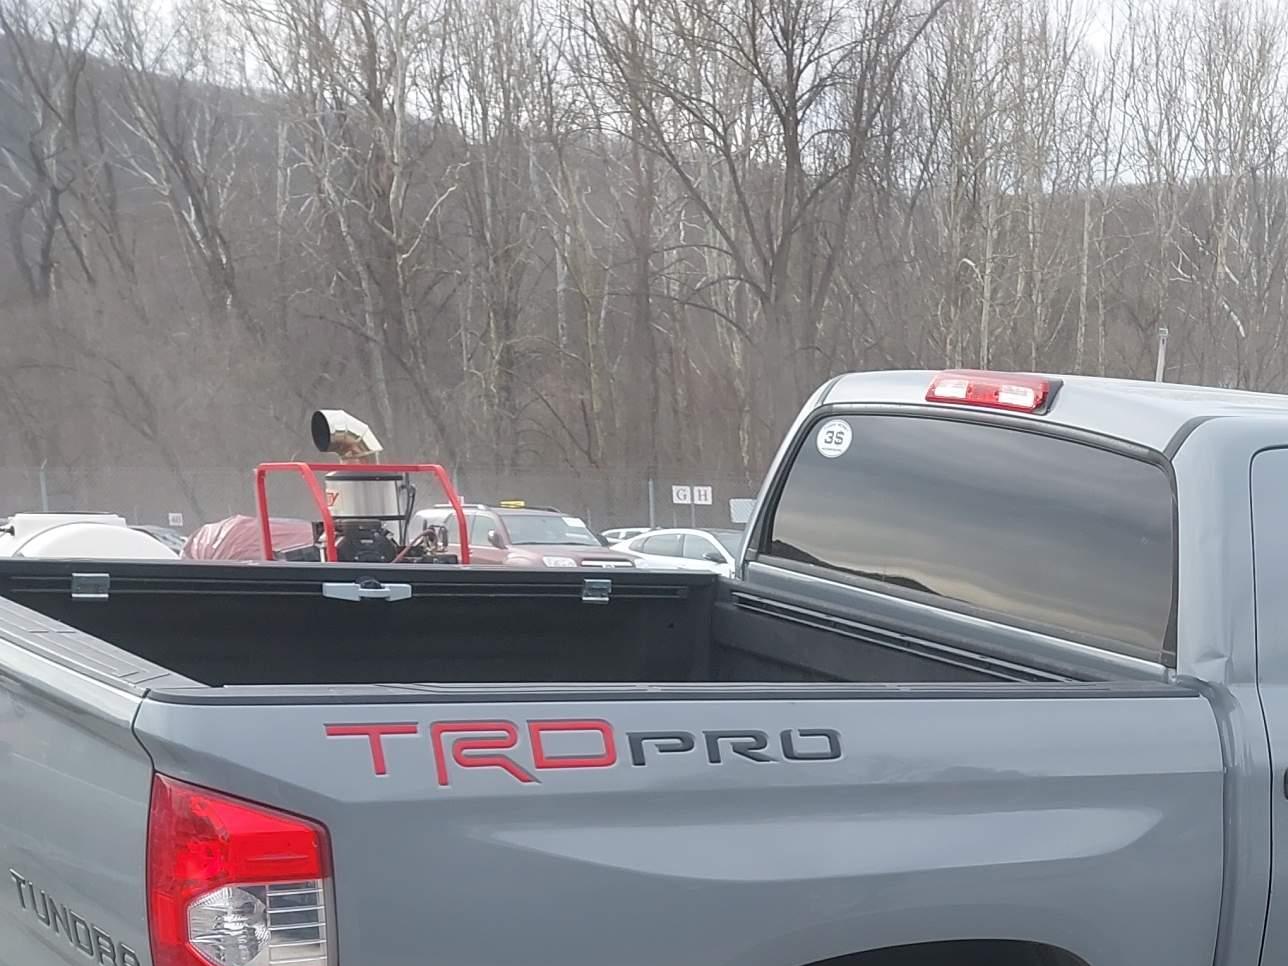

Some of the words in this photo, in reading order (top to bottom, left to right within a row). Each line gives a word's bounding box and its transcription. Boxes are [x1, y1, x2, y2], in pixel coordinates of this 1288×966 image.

[676, 488, 688, 501] G
[697, 488, 709, 502] H
[323, 719, 617, 787] TRD
[625, 728, 843, 767] PRO
